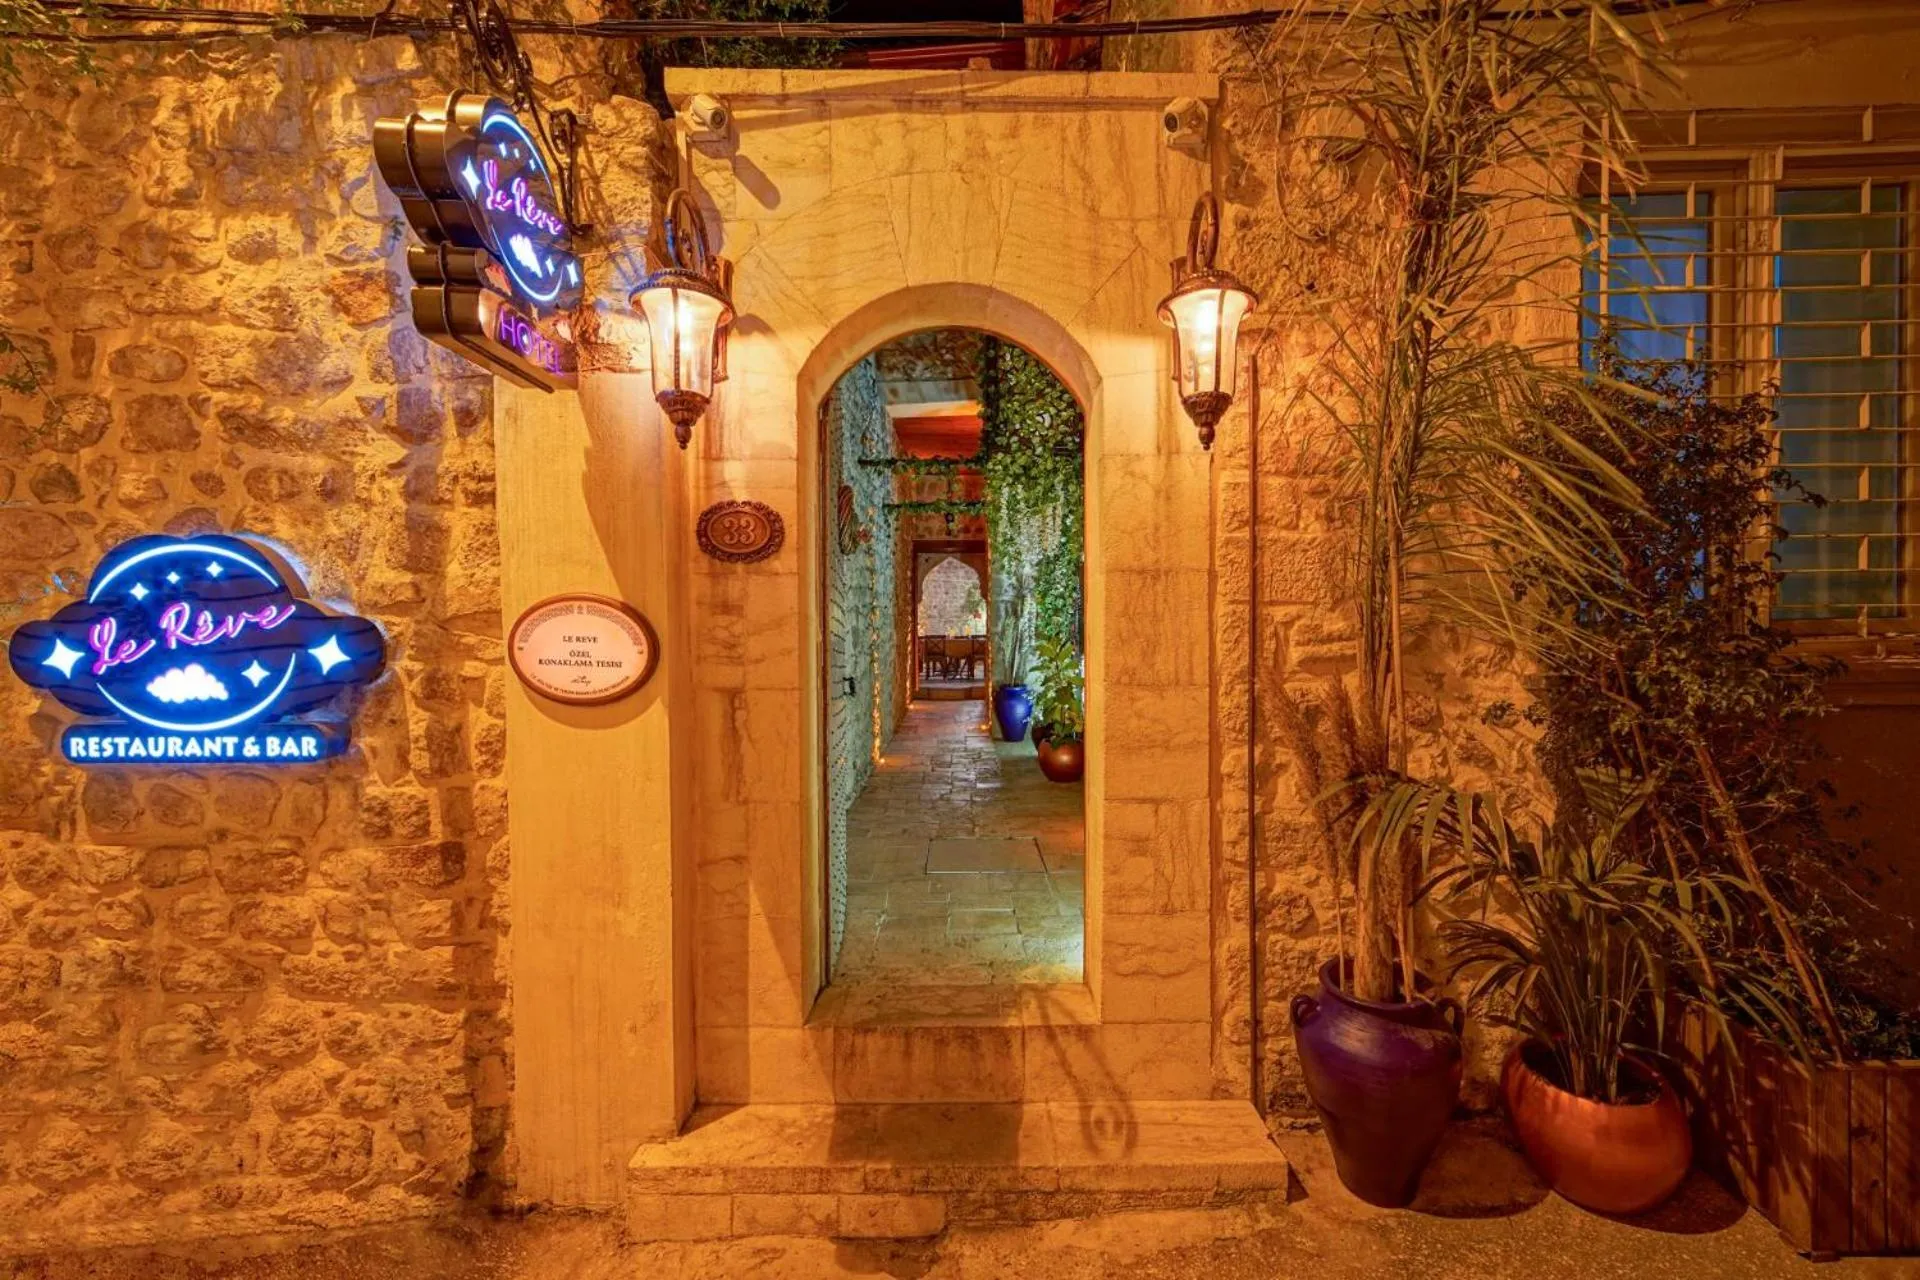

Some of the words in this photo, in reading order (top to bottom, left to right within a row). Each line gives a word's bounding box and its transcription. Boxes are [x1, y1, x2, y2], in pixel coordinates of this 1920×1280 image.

[499, 305, 564, 377] HOTEL
[724, 517, 756, 545] 33
[89, 617, 156, 675] Le
[562, 635, 573, 643] LE
[575, 635, 598, 643] REVE
[538, 658, 593, 667] KONAKLAMA
[70, 736, 239, 757] RESTAURANT
[242, 736, 260, 757] &
[265, 736, 318, 757] BAR
